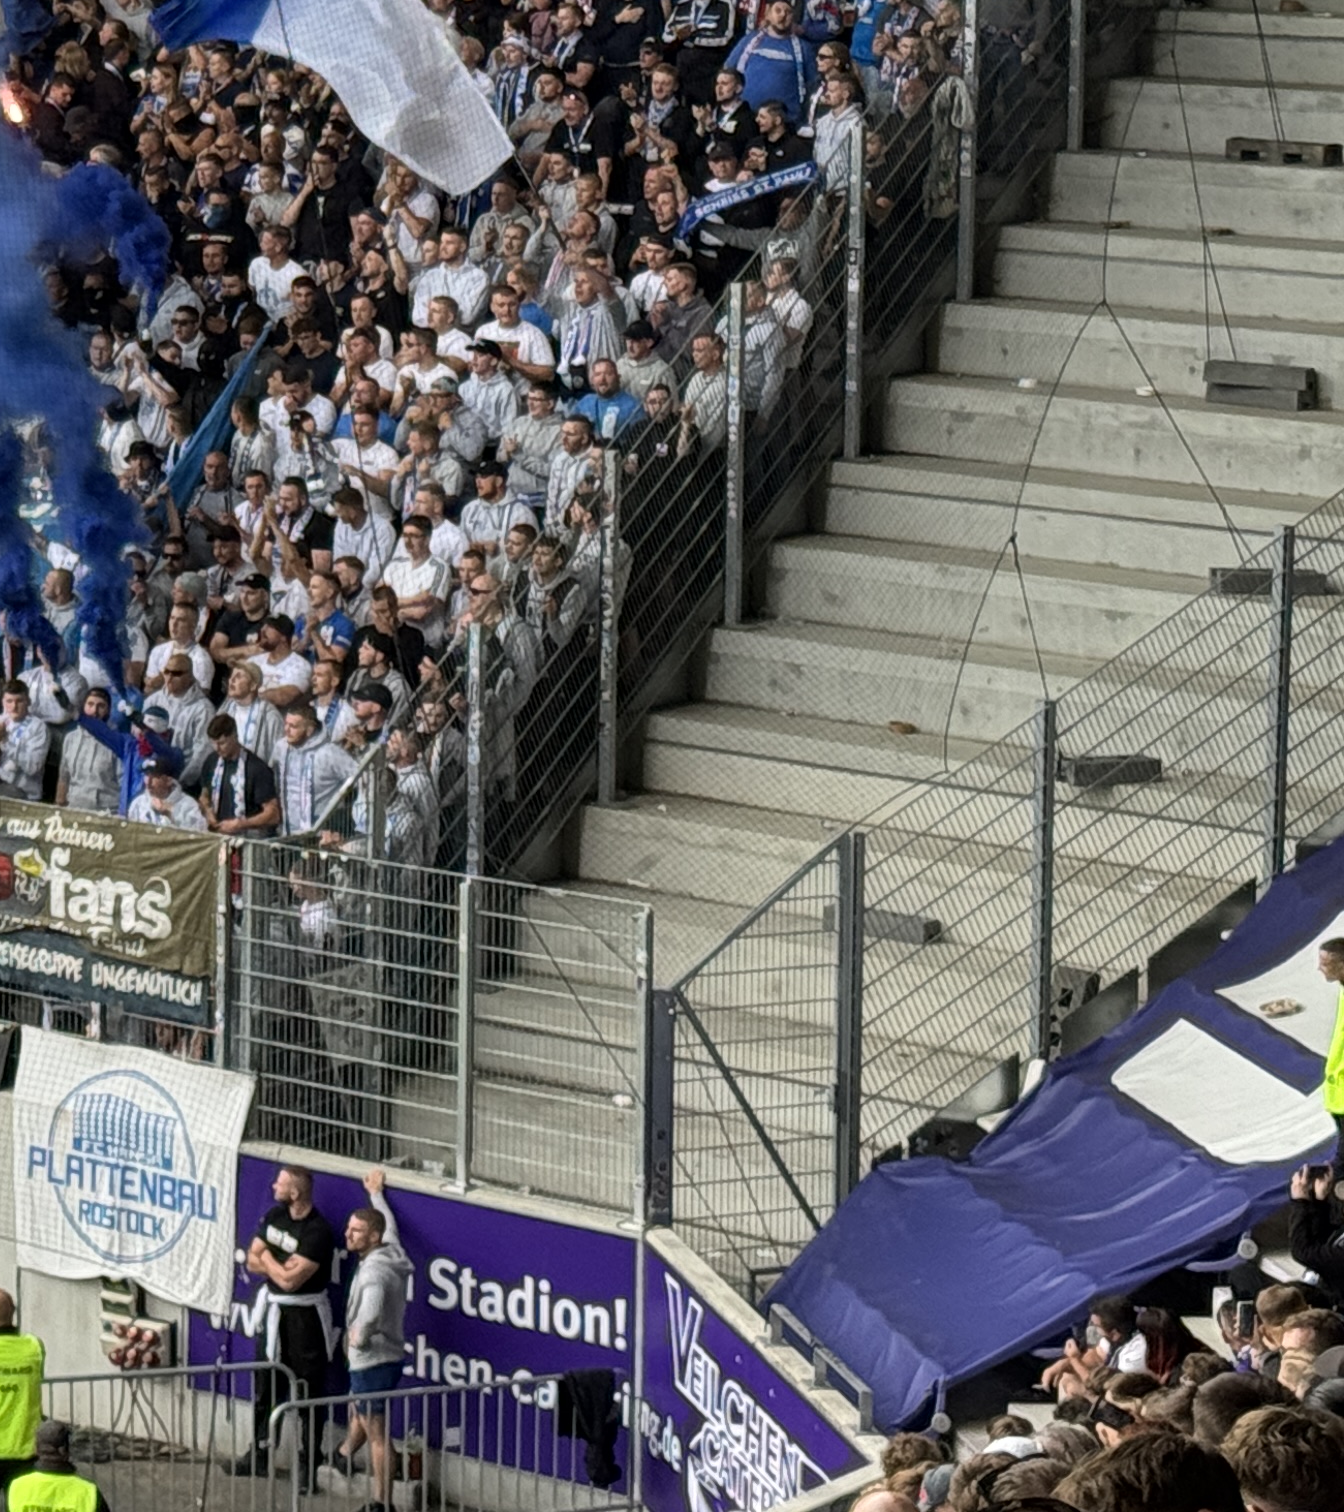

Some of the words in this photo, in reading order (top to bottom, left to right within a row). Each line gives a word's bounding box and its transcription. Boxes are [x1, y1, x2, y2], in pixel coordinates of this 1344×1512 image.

[6, 813, 42, 839] aus
[44, 810, 115, 853] Ruinen
[43, 846, 174, 941] fans
[28, 1145, 218, 1222] PLATTENBAU
[78, 1199, 166, 1242] ROSTOCK
[426, 1256, 629, 1352] Stadion!
